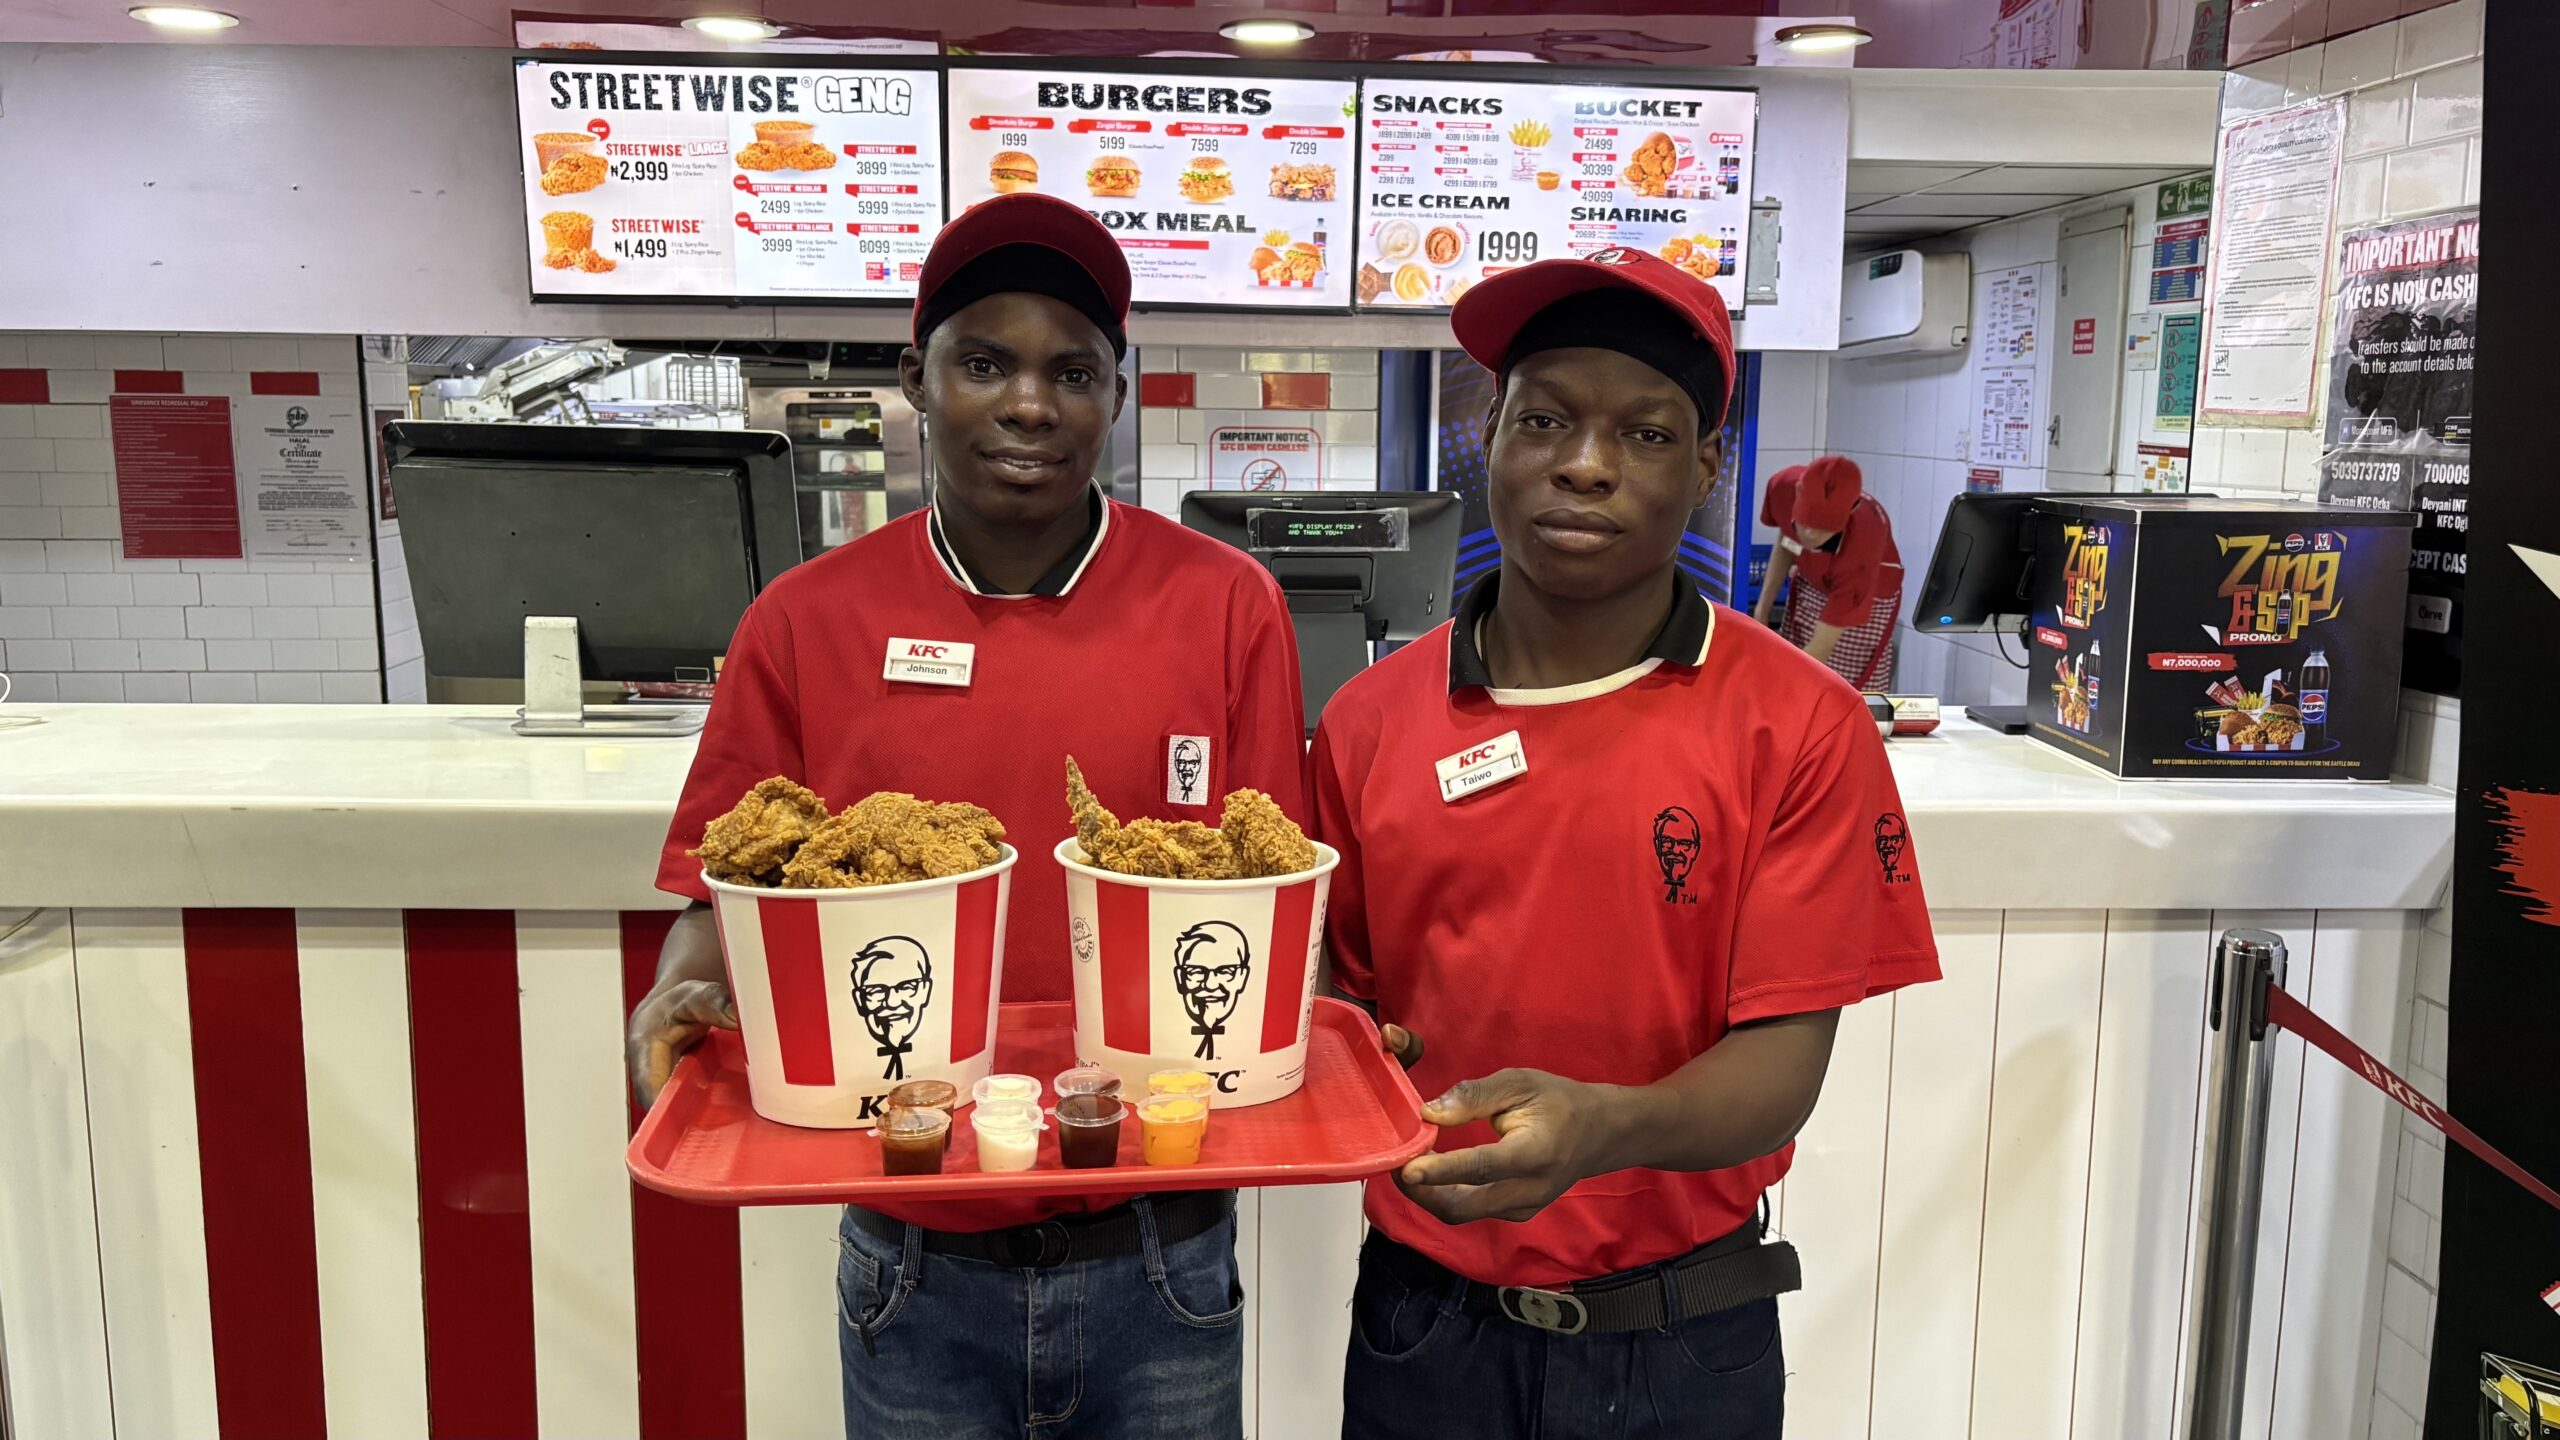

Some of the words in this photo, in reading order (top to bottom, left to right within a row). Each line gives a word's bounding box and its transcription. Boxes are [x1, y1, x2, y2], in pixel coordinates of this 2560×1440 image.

[815, 76, 911, 116] GENG
[1038, 81, 1272, 115] BURGERS
[1373, 94, 1503, 115] SNACKS
[1575, 99, 1702, 118] BUCKET
[1002, 133, 1027, 146] 1999
[1099, 137, 1125, 149] 5199
[1191, 139, 1219, 151] 7599
[1584, 138, 1613, 150] 21499
[606, 143, 682, 156] STREETWISE
[688, 141, 728, 156] LARGE
[1290, 142, 1317, 155] 7299
[856, 161, 887, 175] 3899
[1582, 163, 1613, 176] 30399
[2195, 181, 2210, 192] Fire
[1372, 193, 1412, 208] ICE
[1418, 195, 1510, 210] CREAM
[1581, 191, 1613, 202] 49099
[761, 200, 790, 214] 2499
[858, 200, 888, 215] 5999
[1094, 210, 1149, 231] OX
[1156, 212, 1257, 234] MEAL
[1570, 206, 1687, 224] SHARING
[612, 218, 700, 233] STREETWISE
[762, 238, 792, 252] 3999
[859, 240, 890, 254] 8099
[1478, 230, 1538, 263] 1999
[2346, 226, 2454, 273] IMPORTANT
[2345, 286, 2372, 310] KFC
[2374, 283, 2389, 307] IS
[2391, 278, 2429, 306] NOW
[2357, 337, 2398, 356] Transfers
[2400, 335, 2427, 353] should
[2430, 335, 2441, 350] be
[2443, 333, 2466, 351] made
[2360, 360, 2369, 374] to
[2372, 358, 2387, 374] the
[2389, 358, 2421, 374] account
[2424, 355, 2455, 372] details
[1220, 432, 1274, 442] IMPORTANT
[1276, 432, 1309, 442] NOTICE
[2380, 424, 2393, 436] MFB
[279, 448, 322, 458] Certificate
[1220, 443, 1235, 451] KFC
[1238, 443, 1245, 451] IS
[2331, 461, 2400, 482] 5039737379
[2424, 463, 2470, 485] 700009
[2357, 496, 2371, 510] KFC
[2422, 497, 2451, 513] Devyani
[2437, 514, 2453, 529] KFC
[2063, 526, 2108, 601] Zing
[2217, 534, 2342, 611] Zing
[2230, 633, 2282, 642] PROMO
[907, 663, 947, 675] Johnson
[1461, 770, 1492, 787] Taiwo
[2383, 1072, 2443, 1128] KFC
